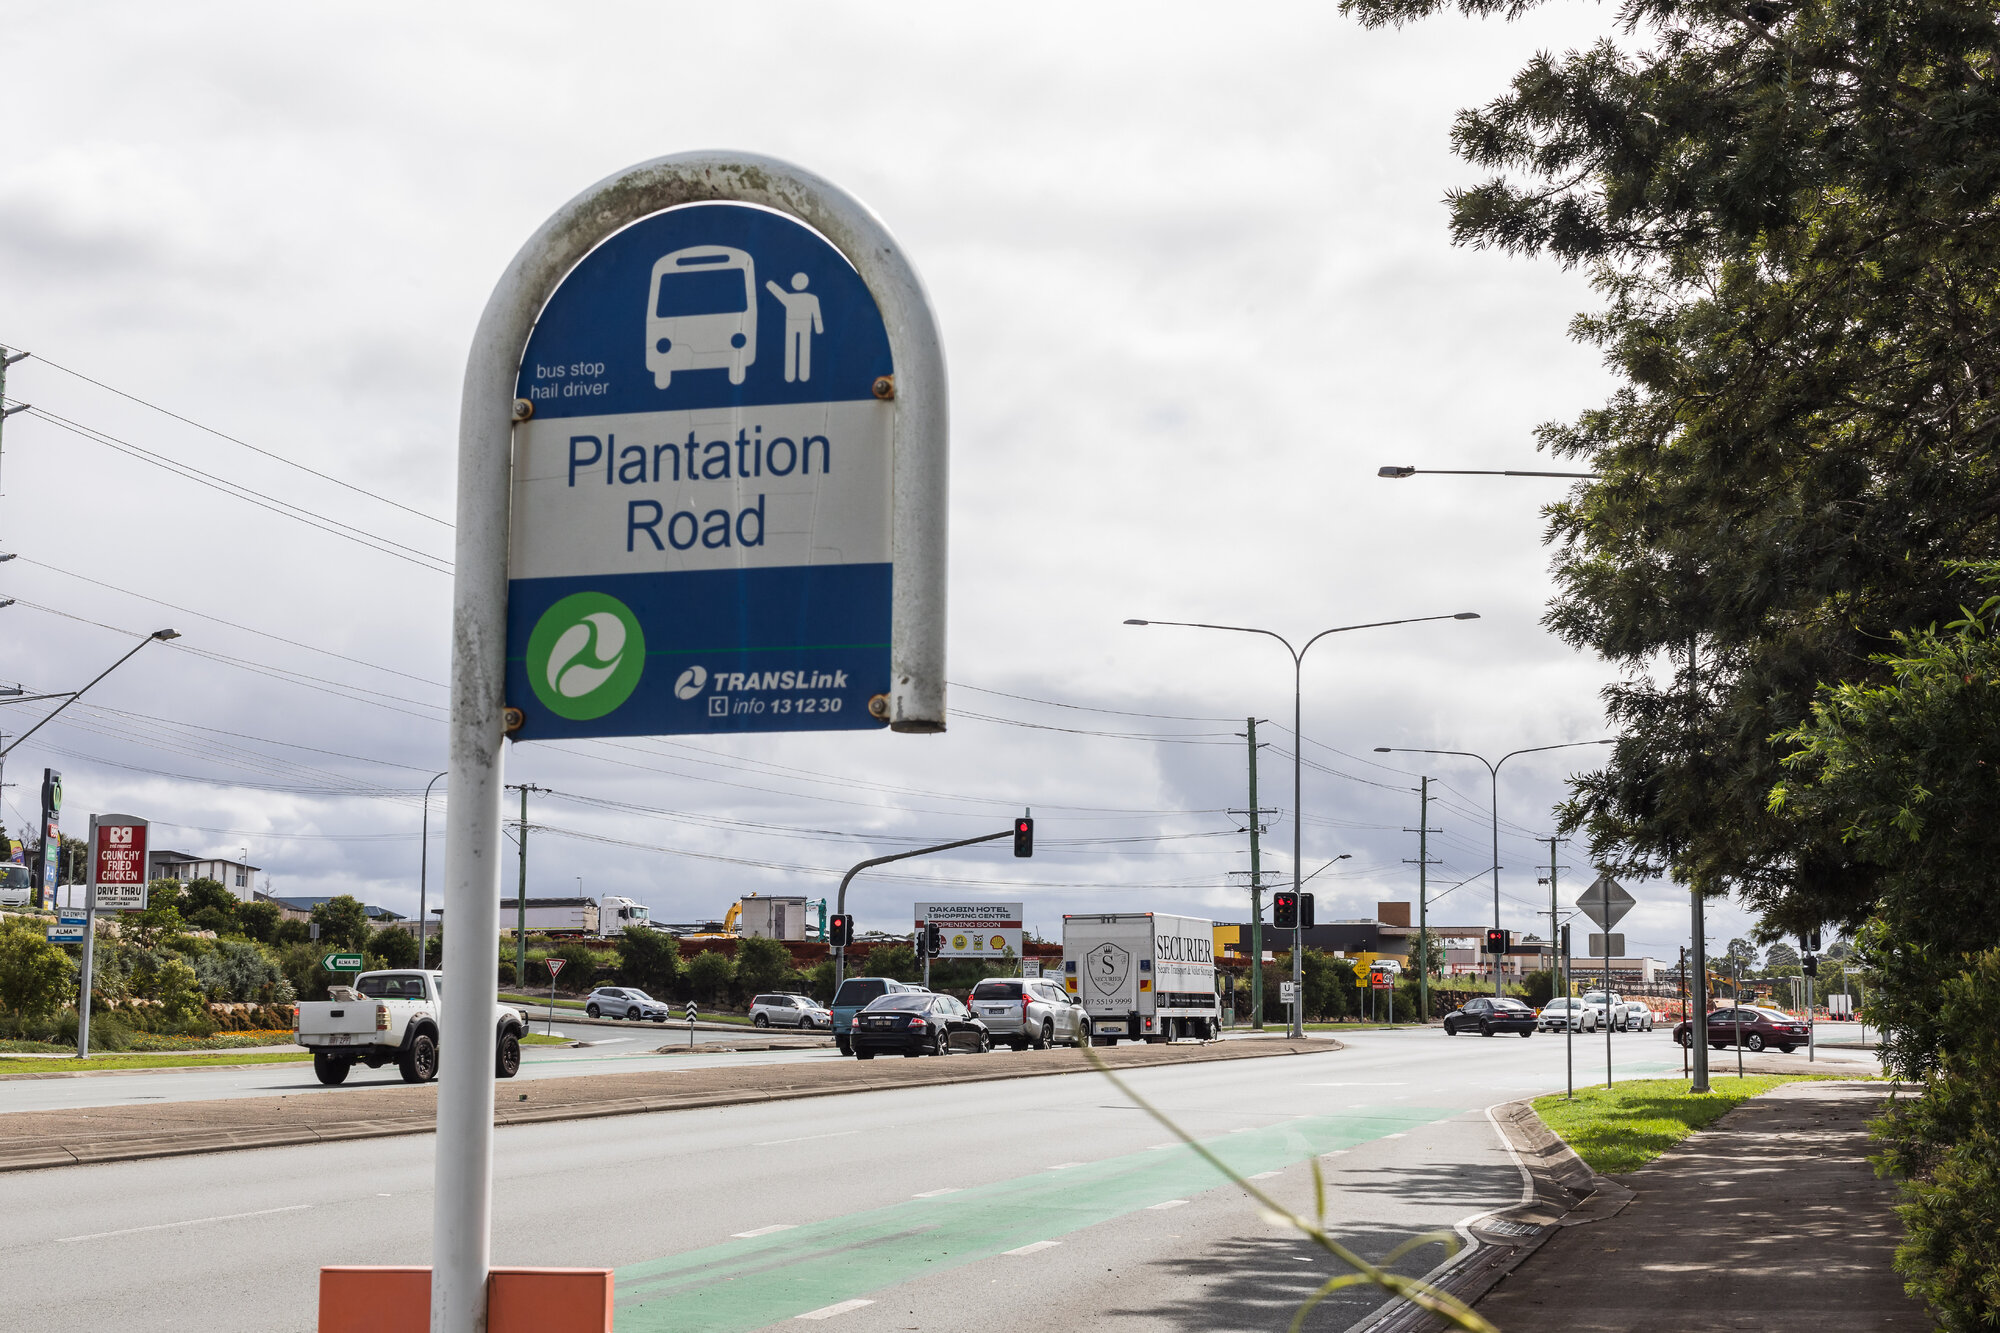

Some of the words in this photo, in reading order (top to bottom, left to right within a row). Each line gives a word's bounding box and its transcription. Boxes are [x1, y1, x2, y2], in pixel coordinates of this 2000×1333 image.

[536, 363, 567, 378] bus
[570, 361, 605, 379] stop
[530, 382, 560, 399] hail
[563, 379, 610, 397] driver
[569, 425, 831, 488] Plantation
[626, 494, 767, 552] Road
[733, 697, 766, 715] info
[101, 850, 141, 861] CRUNCHY
[107, 860, 132, 871] FRIED
[101, 870, 138, 881] CHICKEN
[97, 886, 119, 896] DRIVE
[120, 886, 142, 896] THRU
[1157, 935, 1212, 963] SECURIER
[1102, 955, 1115, 975] S
[1284, 984, 1291, 992] U
[1085, 998, 1095, 1006] 07
[1096, 998, 1113, 1006] 5519
[1114, 998, 1133, 1006] 9999
